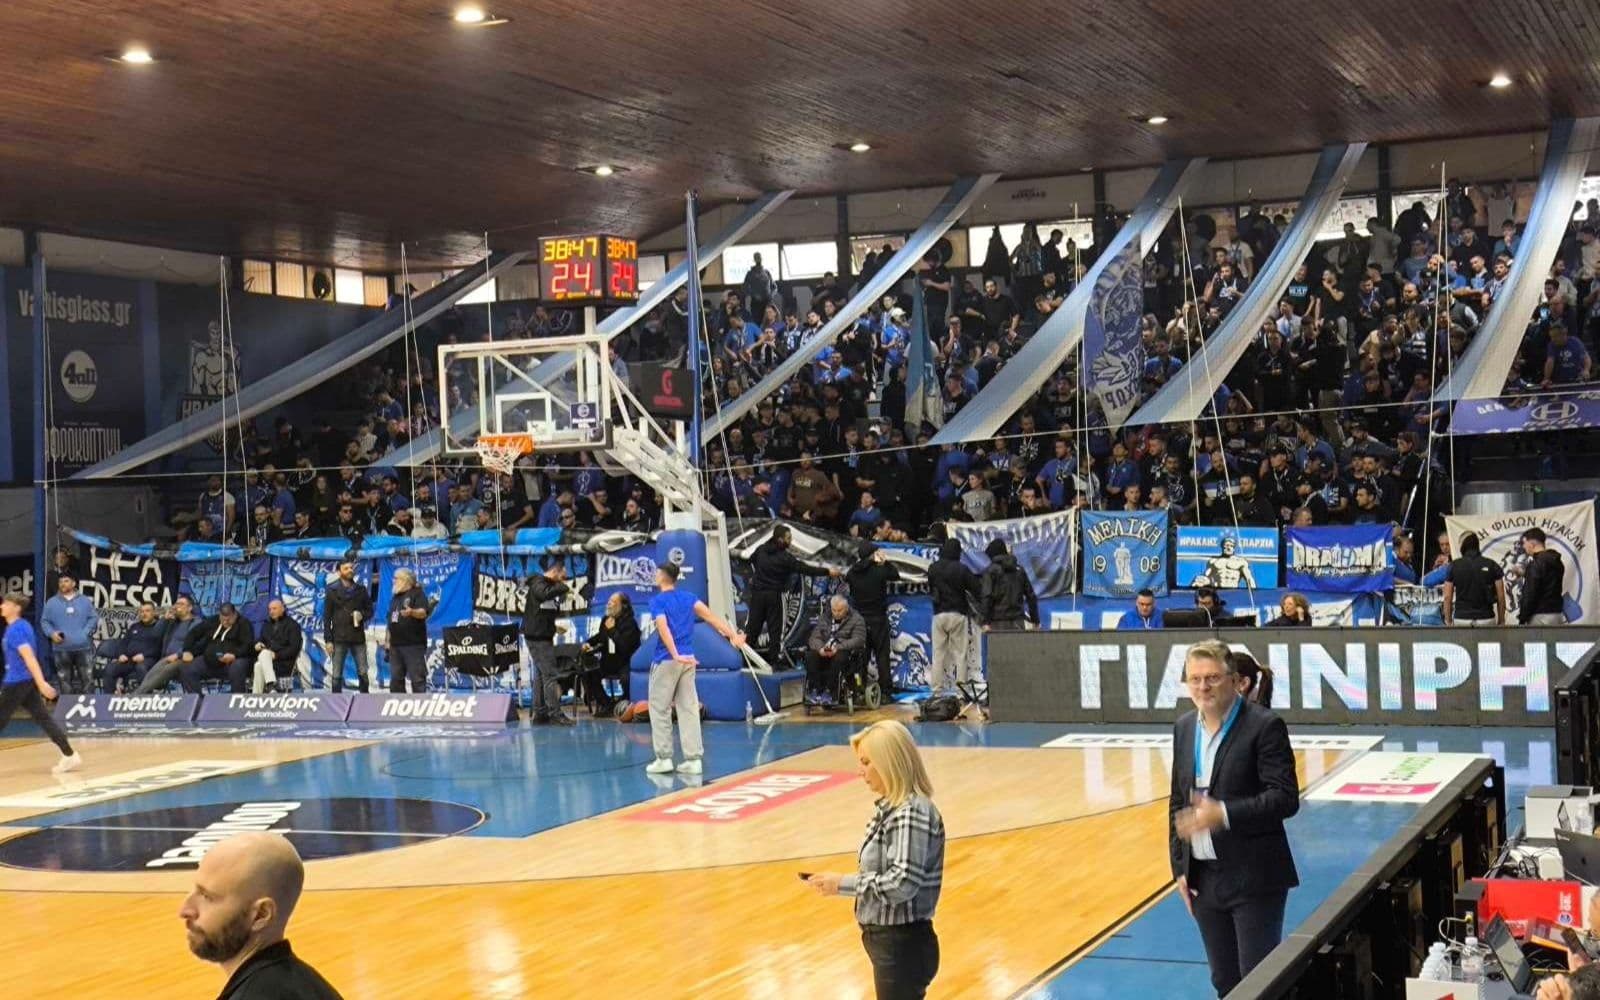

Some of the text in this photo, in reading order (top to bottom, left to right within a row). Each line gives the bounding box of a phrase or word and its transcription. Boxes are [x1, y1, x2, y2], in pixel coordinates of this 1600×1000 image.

[544, 238, 598, 261] 38:47
[607, 238, 638, 260] 38:47
[551, 263, 591, 294] 24
[611, 262, 636, 292] 24
[18, 289, 132, 327] Vtisglass.gr
[1087, 518, 1162, 546] ΜΕΛΙΚΗ
[1491, 516, 1586, 551] ΦΙΛΩΝ ΗΡΑΚΛΗ
[1092, 556, 1160, 573] 19 08
[448, 644, 488, 655] SPALDING
[108, 696, 181, 711] mentor
[229, 694, 320, 710] Γιαννίρης
[381, 694, 477, 717] novibet
[244, 710, 298, 719] Automobility
